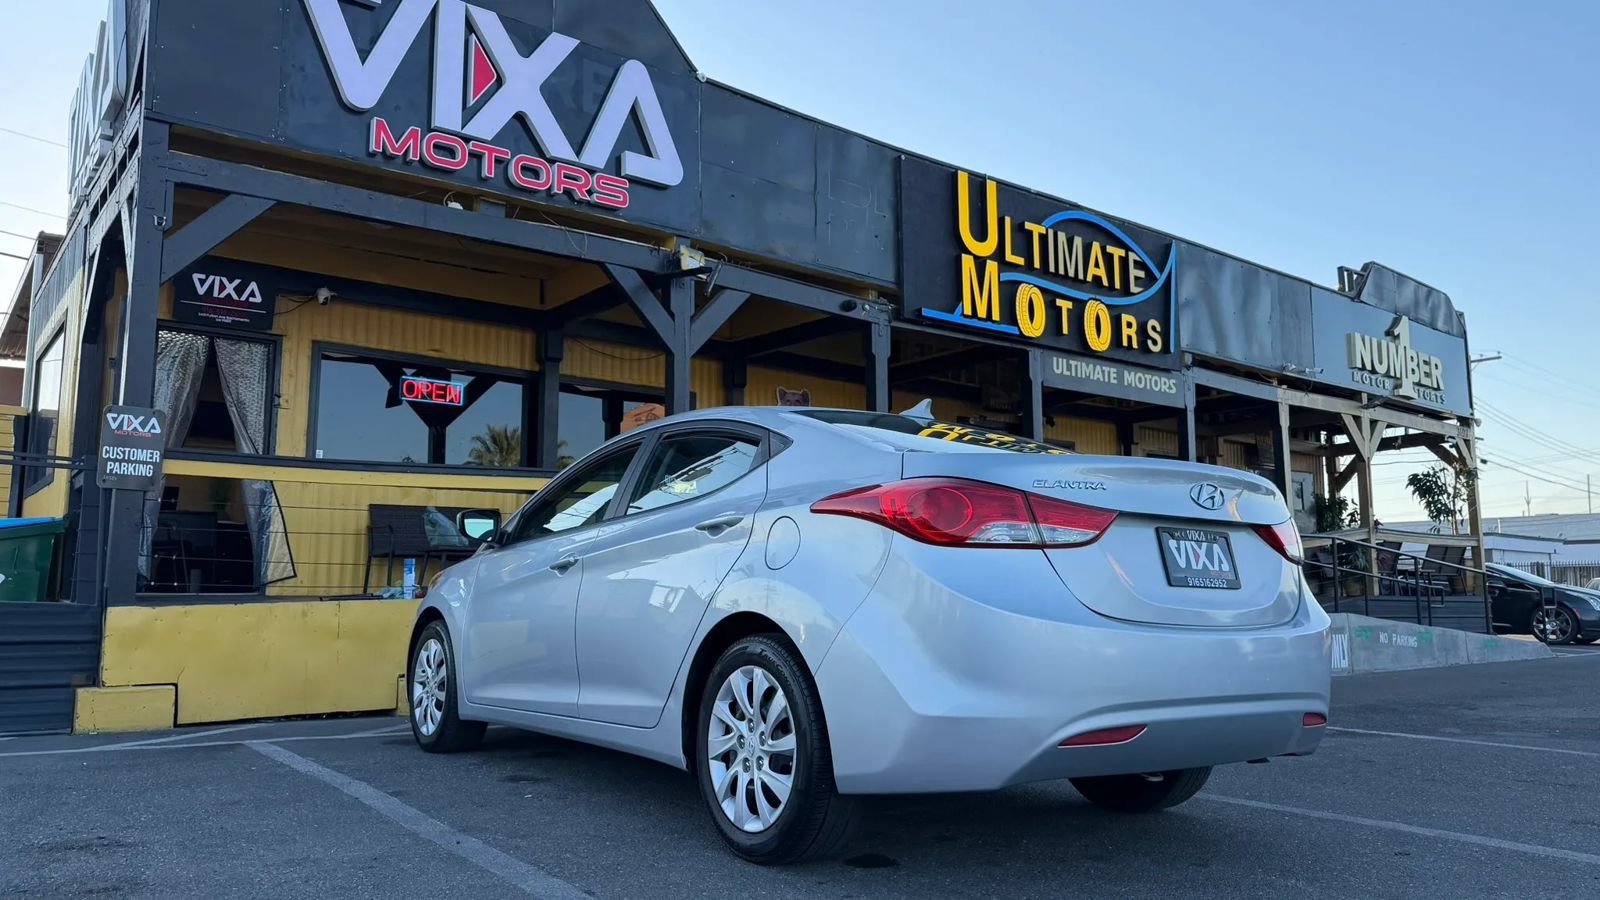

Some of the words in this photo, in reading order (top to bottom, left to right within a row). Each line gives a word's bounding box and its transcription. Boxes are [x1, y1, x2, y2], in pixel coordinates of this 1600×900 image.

[303, 0, 684, 188] VIXA
[369, 117, 630, 209] MOTORS
[957, 170, 1146, 294] ULTIMATE
[192, 273, 262, 303] VIXA
[961, 253, 1163, 353] MOTORS
[1348, 332, 1444, 390] NUMBER
[1053, 357, 1118, 384] ULTIMATE
[1124, 370, 1177, 394] MOTORS
[1352, 370, 1390, 391] MOTOR
[402, 379, 460, 404] OPEN
[106, 413, 161, 434] VIXA
[114, 429, 152, 438] MOTORS
[102, 446, 160, 463] CUSTOMER
[106, 461, 153, 477] PARKING
[1033, 479, 1107, 490] ELANTRA
[1186, 530, 1206, 541] VIXA
[1168, 539, 1230, 572] VIXA
[1331, 634, 1349, 669] NLY
[1379, 632, 1389, 644] NO
[1392, 634, 1418, 648] PARKING
